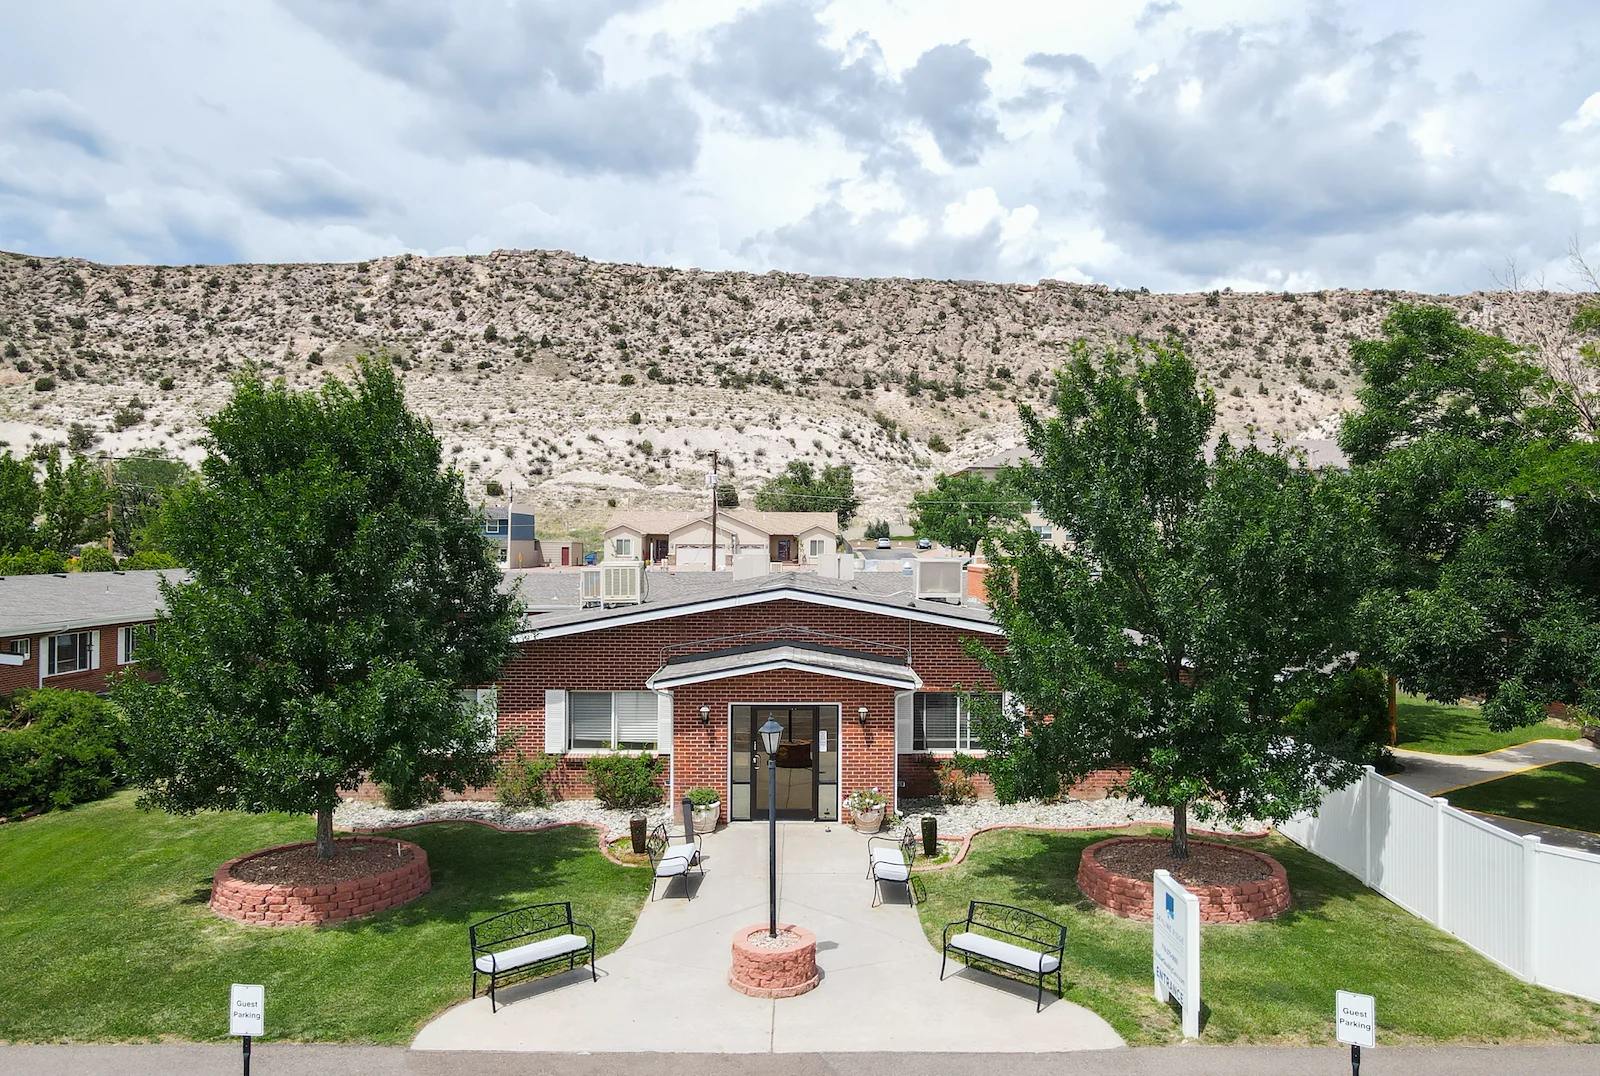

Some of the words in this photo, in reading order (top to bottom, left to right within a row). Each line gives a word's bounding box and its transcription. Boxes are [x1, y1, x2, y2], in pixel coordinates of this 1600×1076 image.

[1156, 965, 1184, 1005] ENTRANCE
[233, 1011, 261, 1020] Parking
[1342, 1007, 1367, 1018] Guest
[1339, 1017, 1371, 1031] Parking
